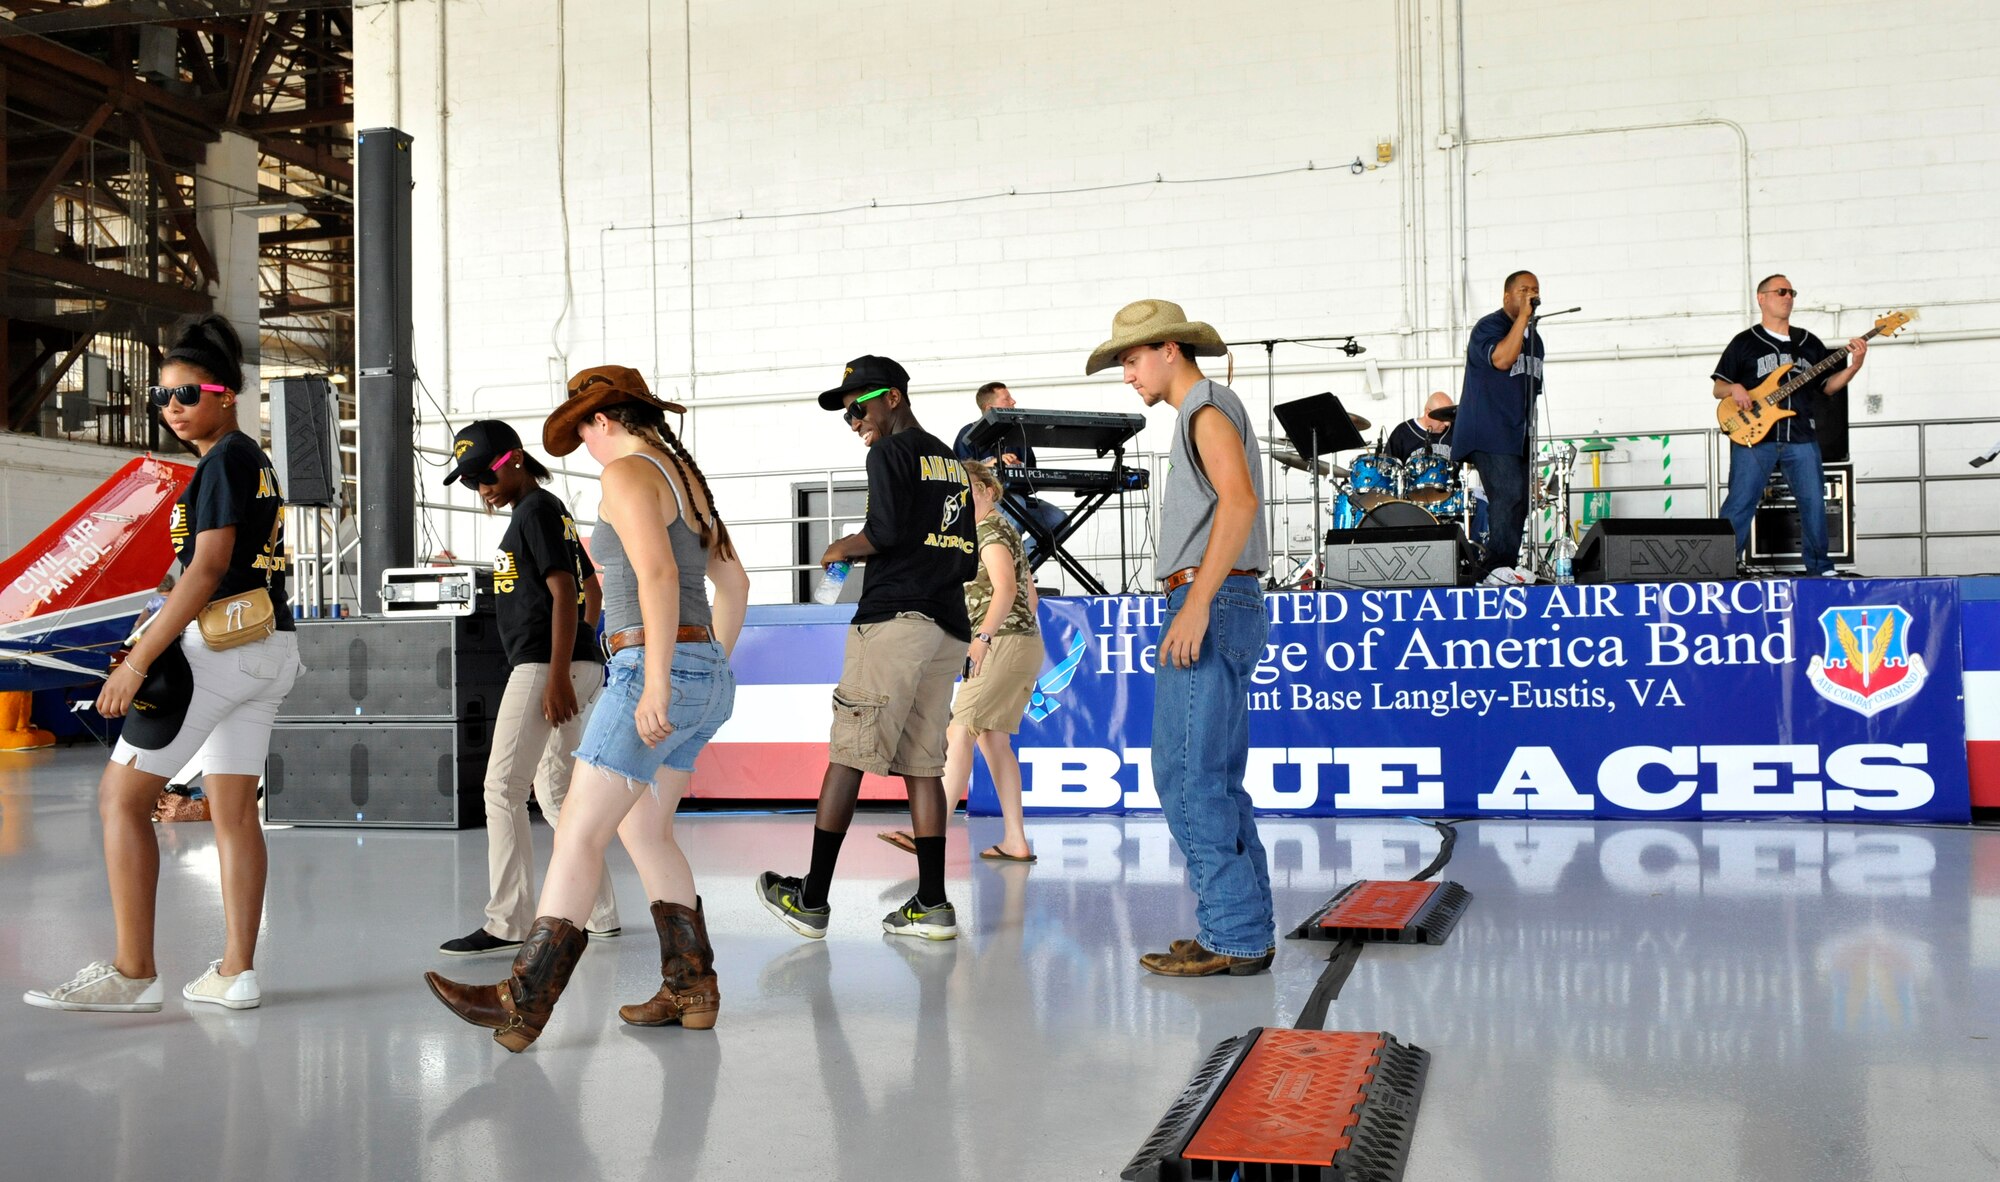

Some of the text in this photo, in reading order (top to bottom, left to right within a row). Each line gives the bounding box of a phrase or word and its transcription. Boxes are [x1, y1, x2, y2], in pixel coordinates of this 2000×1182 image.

[13, 518, 100, 594] CIVIL AIR
[36, 541, 113, 604] PATROL
[1361, 584, 1525, 622] STATES
[1541, 584, 1618, 619] AIR
[1635, 579, 1794, 616] FORCE
[1325, 627, 1386, 672] of
[1394, 623, 1628, 670] America
[1645, 619, 1797, 666] Band
[1290, 683, 1362, 710] Base
[1371, 679, 1616, 717] Langley-Eustis,
[1626, 678, 1686, 707] VA
[1816, 672, 1919, 709] AIR COMBAT COMMAND
[1477, 743, 1936, 812] ACES
